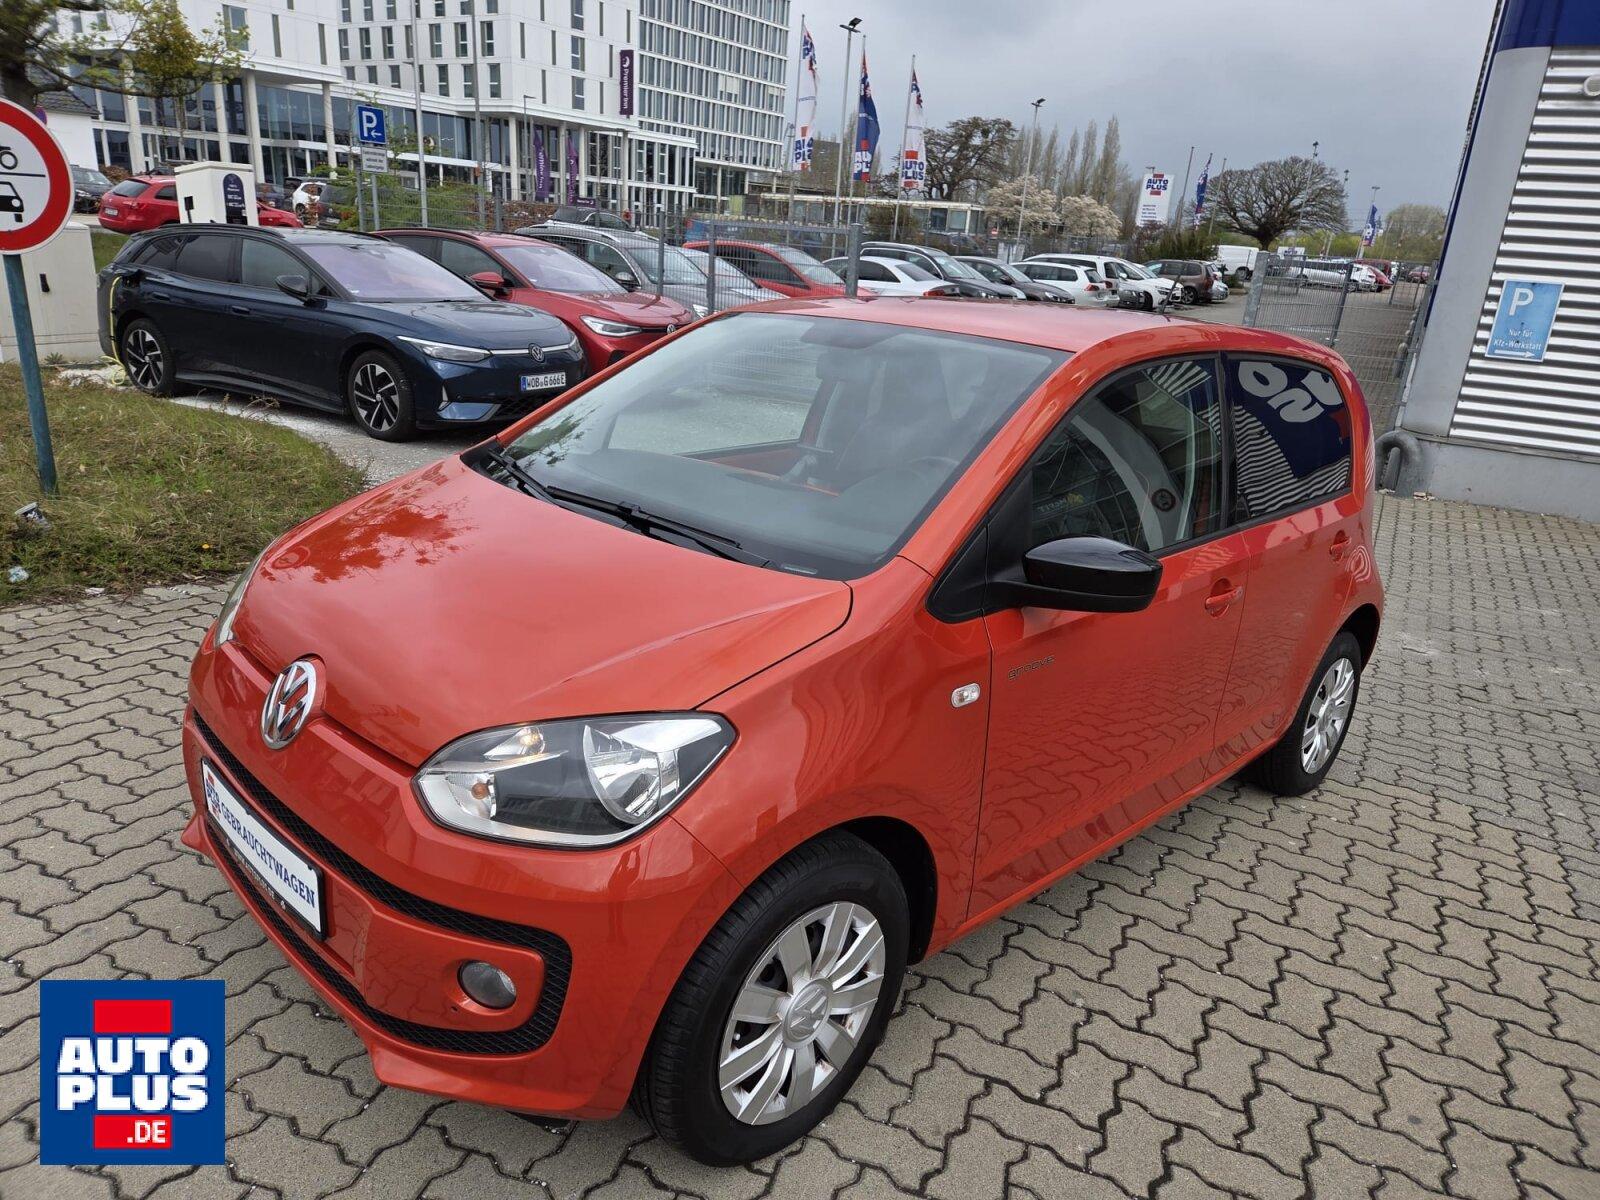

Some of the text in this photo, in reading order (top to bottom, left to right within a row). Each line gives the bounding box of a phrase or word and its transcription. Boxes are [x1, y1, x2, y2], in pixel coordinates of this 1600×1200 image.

[362, 111, 377, 137] P
[1509, 288, 1534, 316] P
[1522, 329, 1533, 337] für
[1008, 655, 1054, 681] groove
[221, 804, 316, 908] GEBRAUCHTWAGEN
